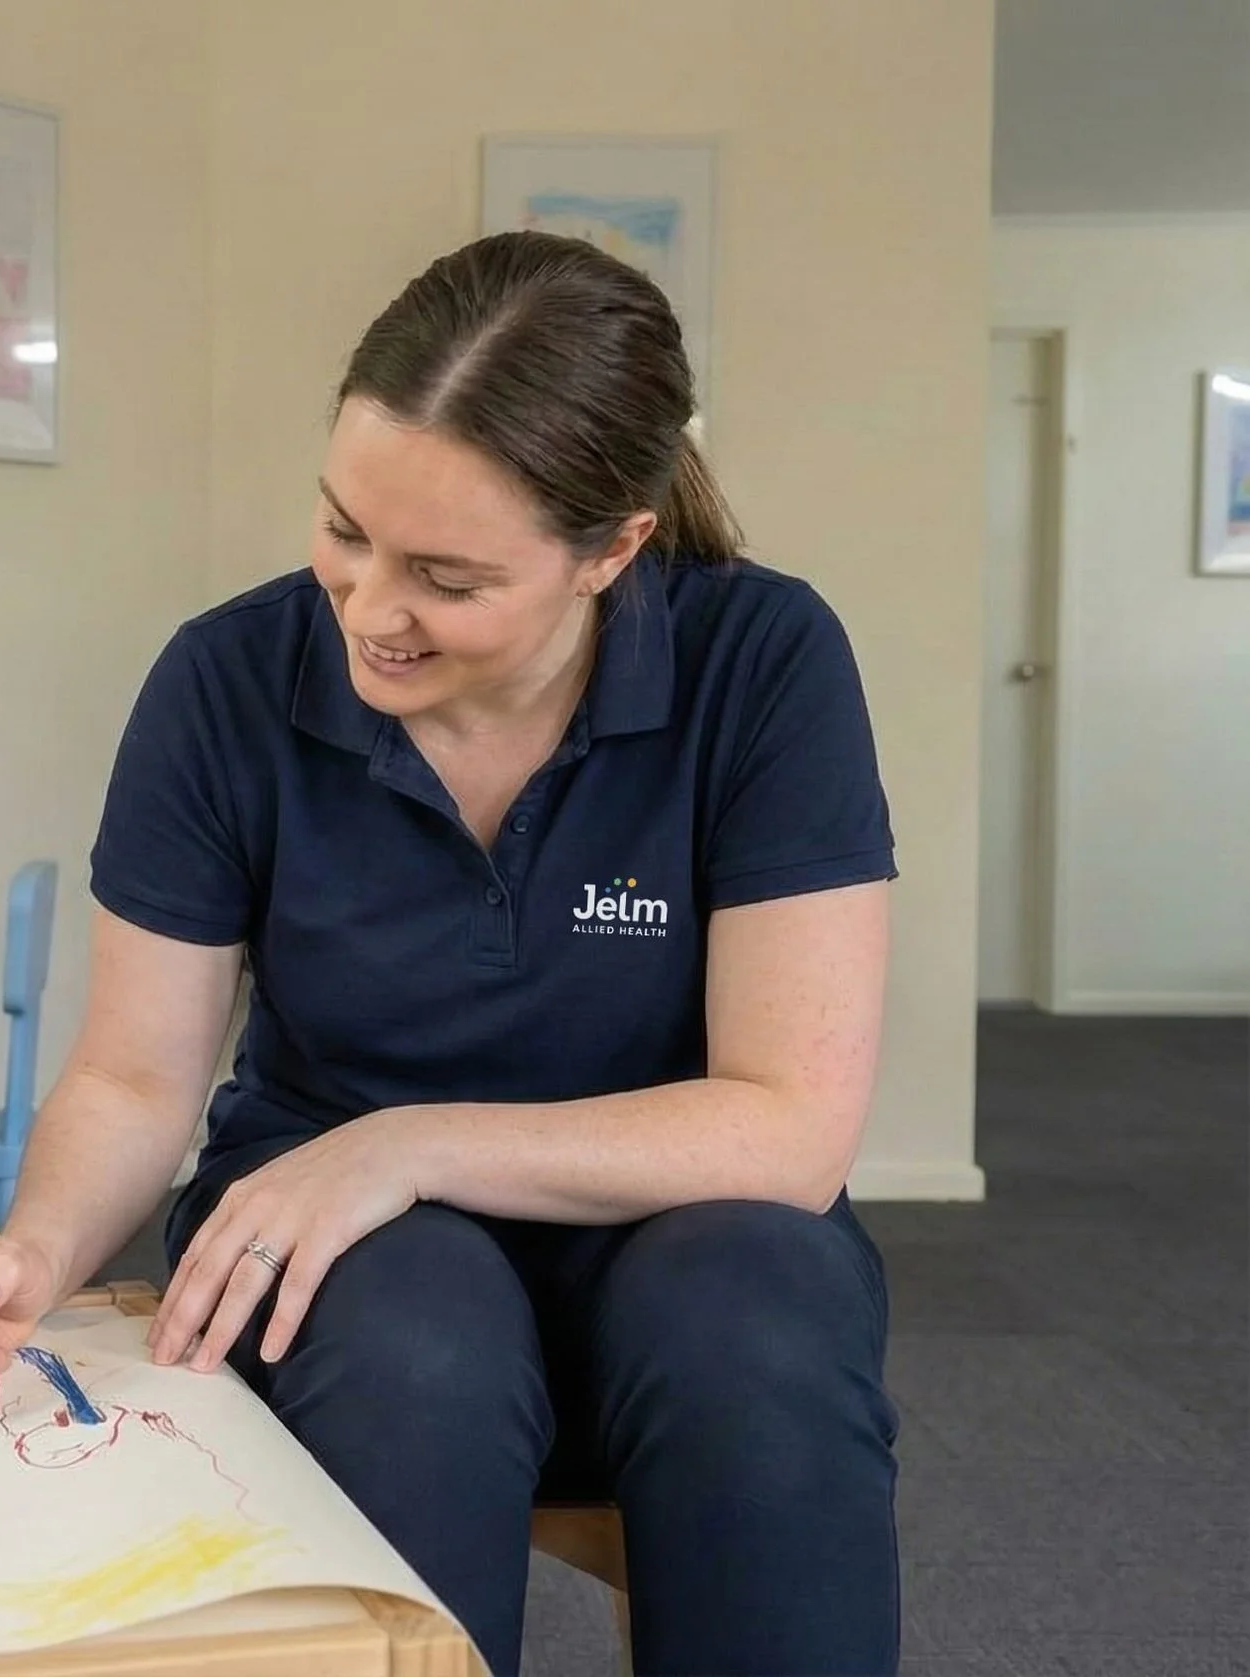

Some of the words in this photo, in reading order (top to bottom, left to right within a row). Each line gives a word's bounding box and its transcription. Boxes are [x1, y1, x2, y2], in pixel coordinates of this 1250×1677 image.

[573, 884, 668, 924] Jelm
[572, 924, 615, 934] ALLIED
[619, 926, 667, 937] HEALTH
